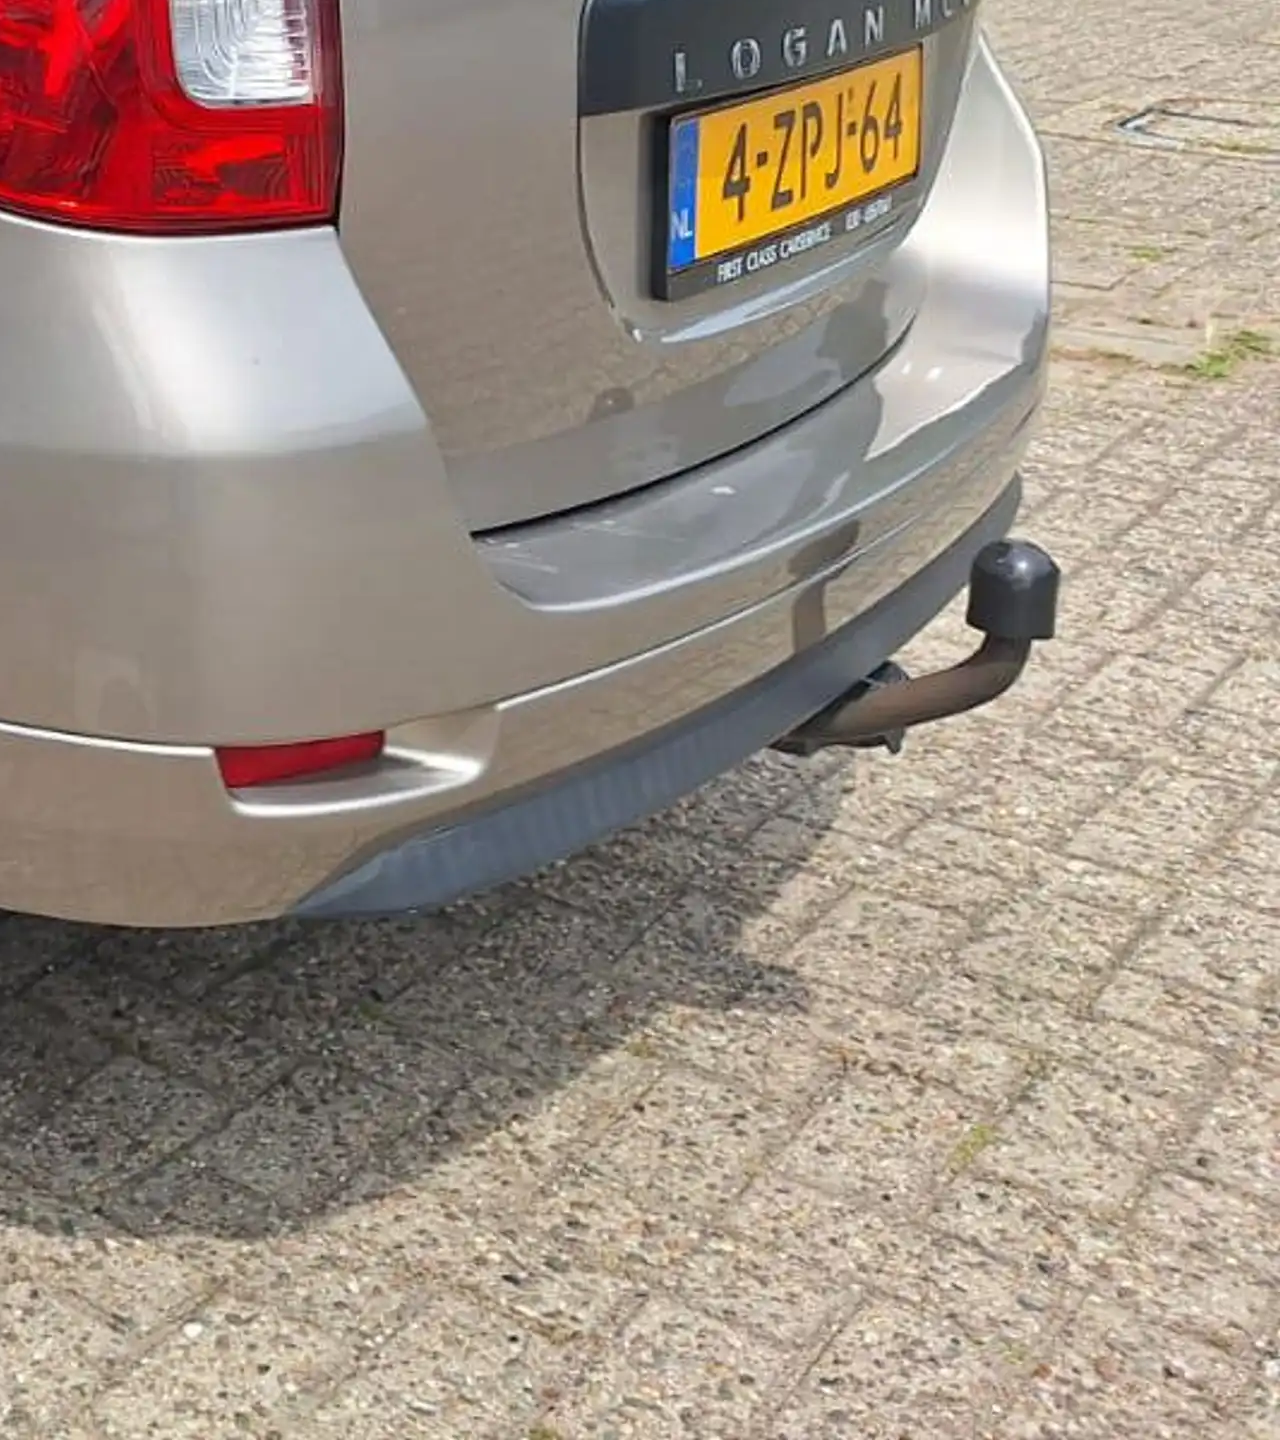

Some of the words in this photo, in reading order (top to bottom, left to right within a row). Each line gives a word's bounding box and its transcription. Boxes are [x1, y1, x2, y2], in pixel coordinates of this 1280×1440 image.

[672, 4, 886, 93] LOGAN
[722, 71, 903, 223] 4-ZPJ-64
[671, 212, 693, 241] NL
[717, 256, 743, 283] FIRST
[747, 244, 777, 271] CLASS
